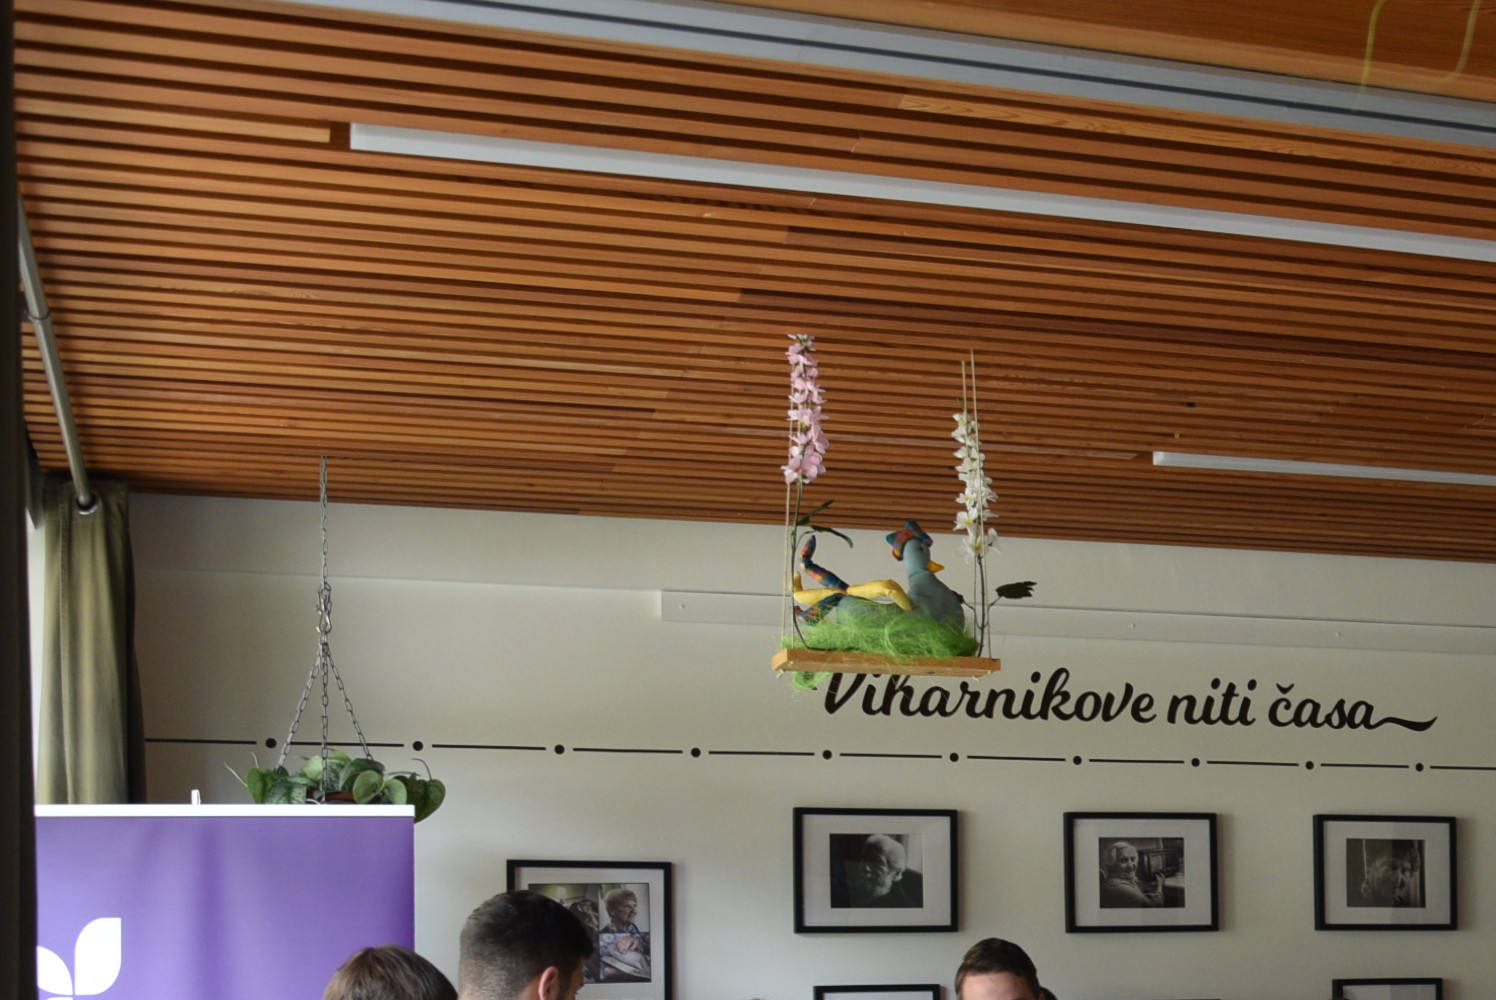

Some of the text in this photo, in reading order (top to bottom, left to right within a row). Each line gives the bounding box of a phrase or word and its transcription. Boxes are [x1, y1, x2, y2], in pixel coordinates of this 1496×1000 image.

[824, 667, 1438, 731] Viharnikove niti časa
